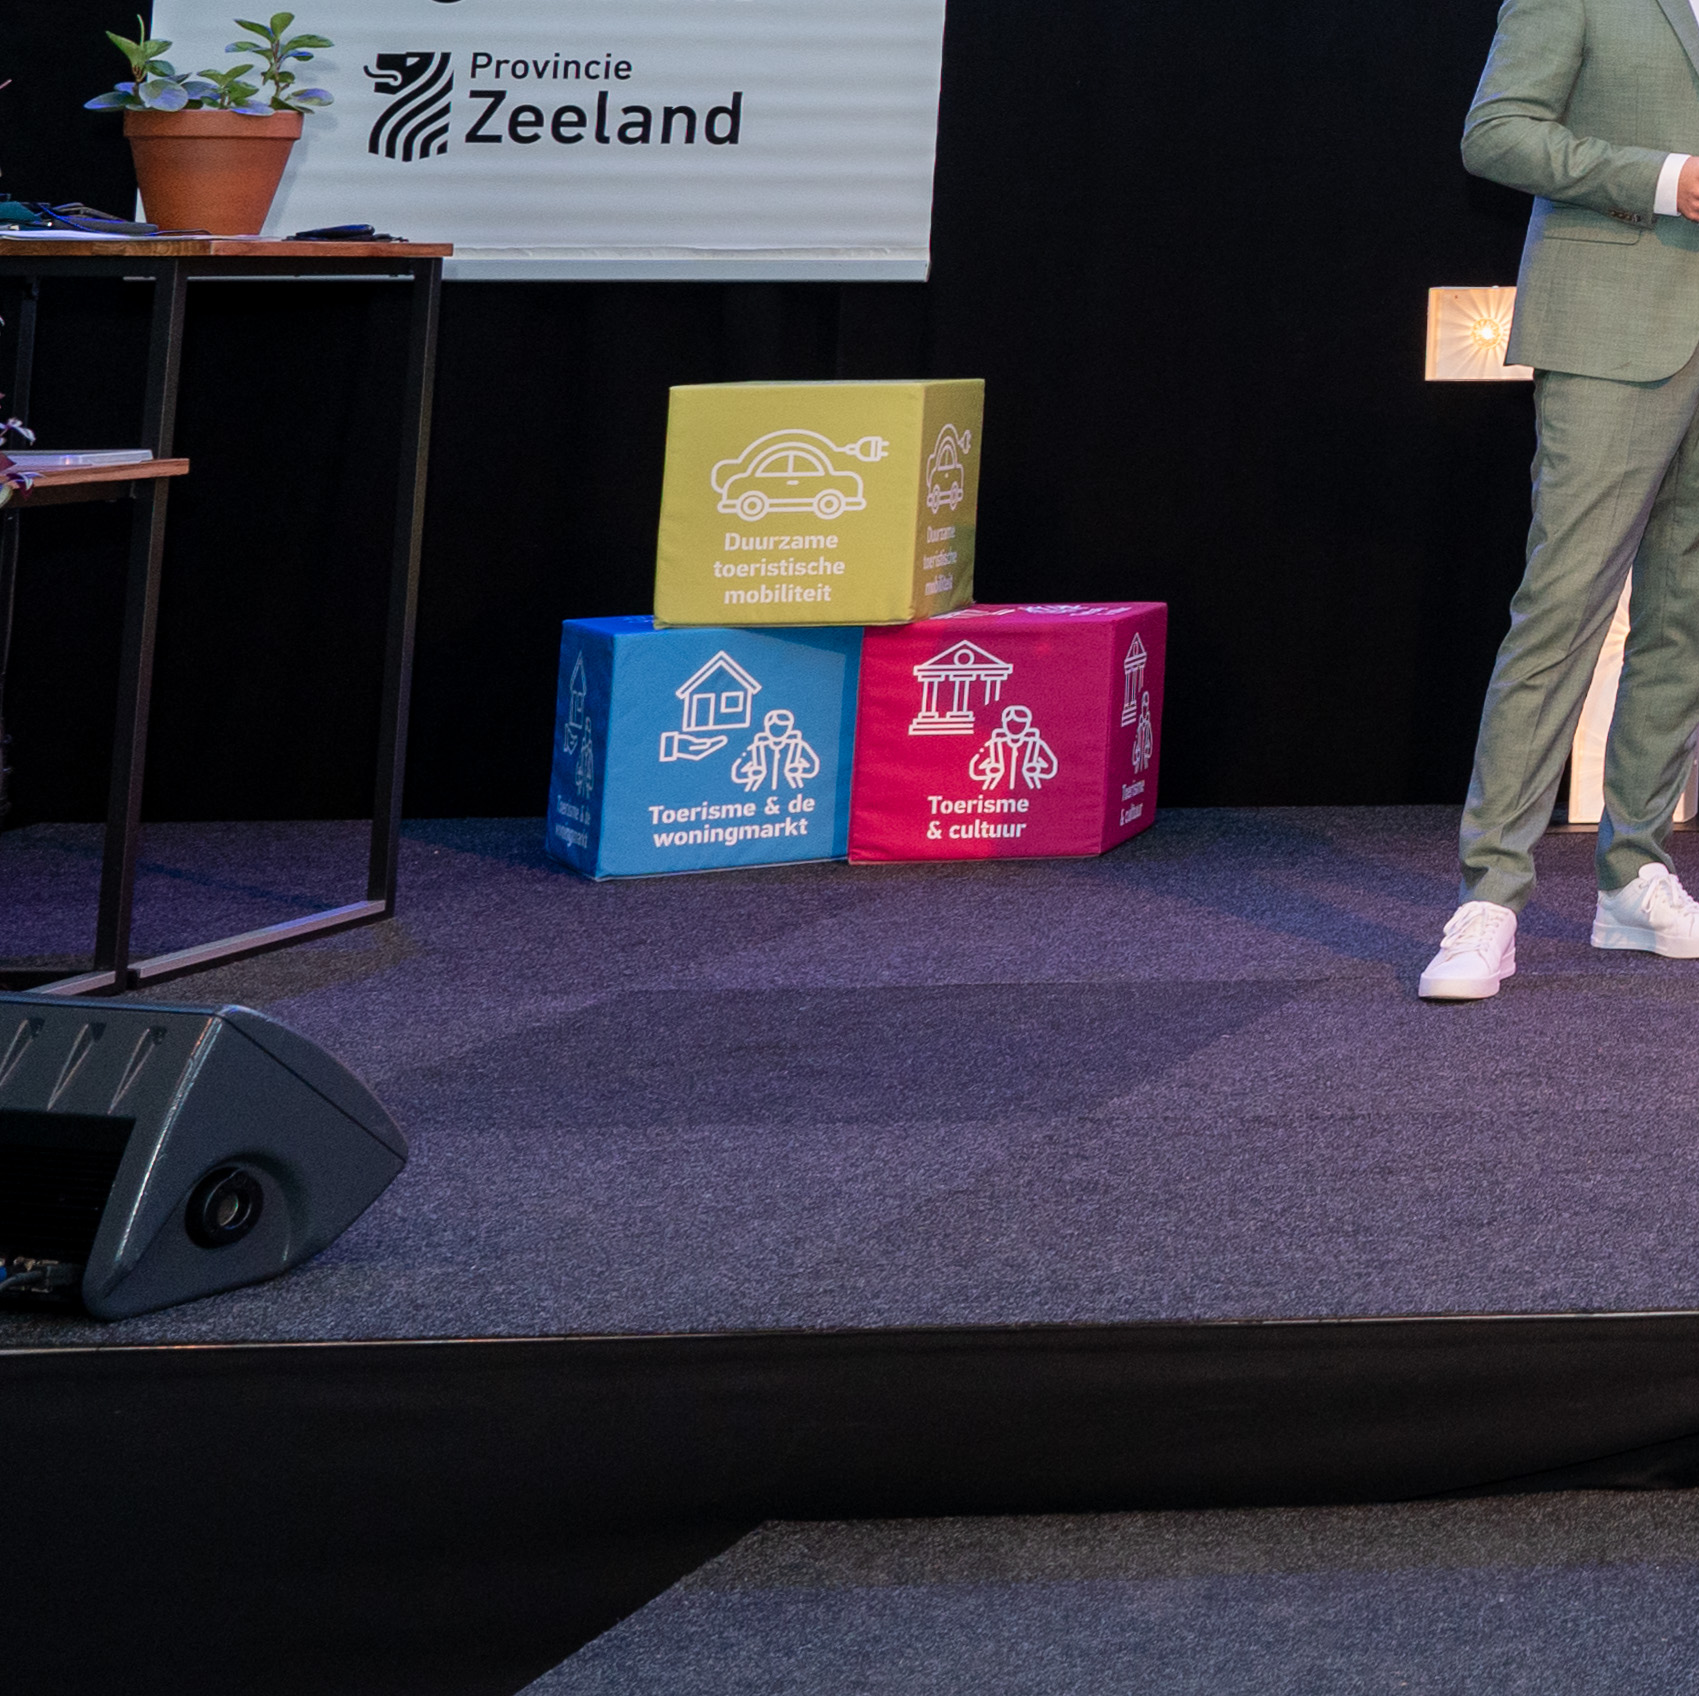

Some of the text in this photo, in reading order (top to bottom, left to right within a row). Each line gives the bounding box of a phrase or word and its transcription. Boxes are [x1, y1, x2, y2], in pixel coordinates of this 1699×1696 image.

[470, 52, 633, 81] Provincie
[464, 90, 743, 146] Zeeland
[724, 532, 838, 551] Duurzame
[713, 557, 845, 578] toeristische
[724, 584, 831, 604] mobiliteit
[648, 794, 815, 824] Toerisme & de
[927, 795, 1029, 814] Toerisme
[653, 818, 808, 848] woningmarkt
[926, 819, 1026, 839] & cultuur
